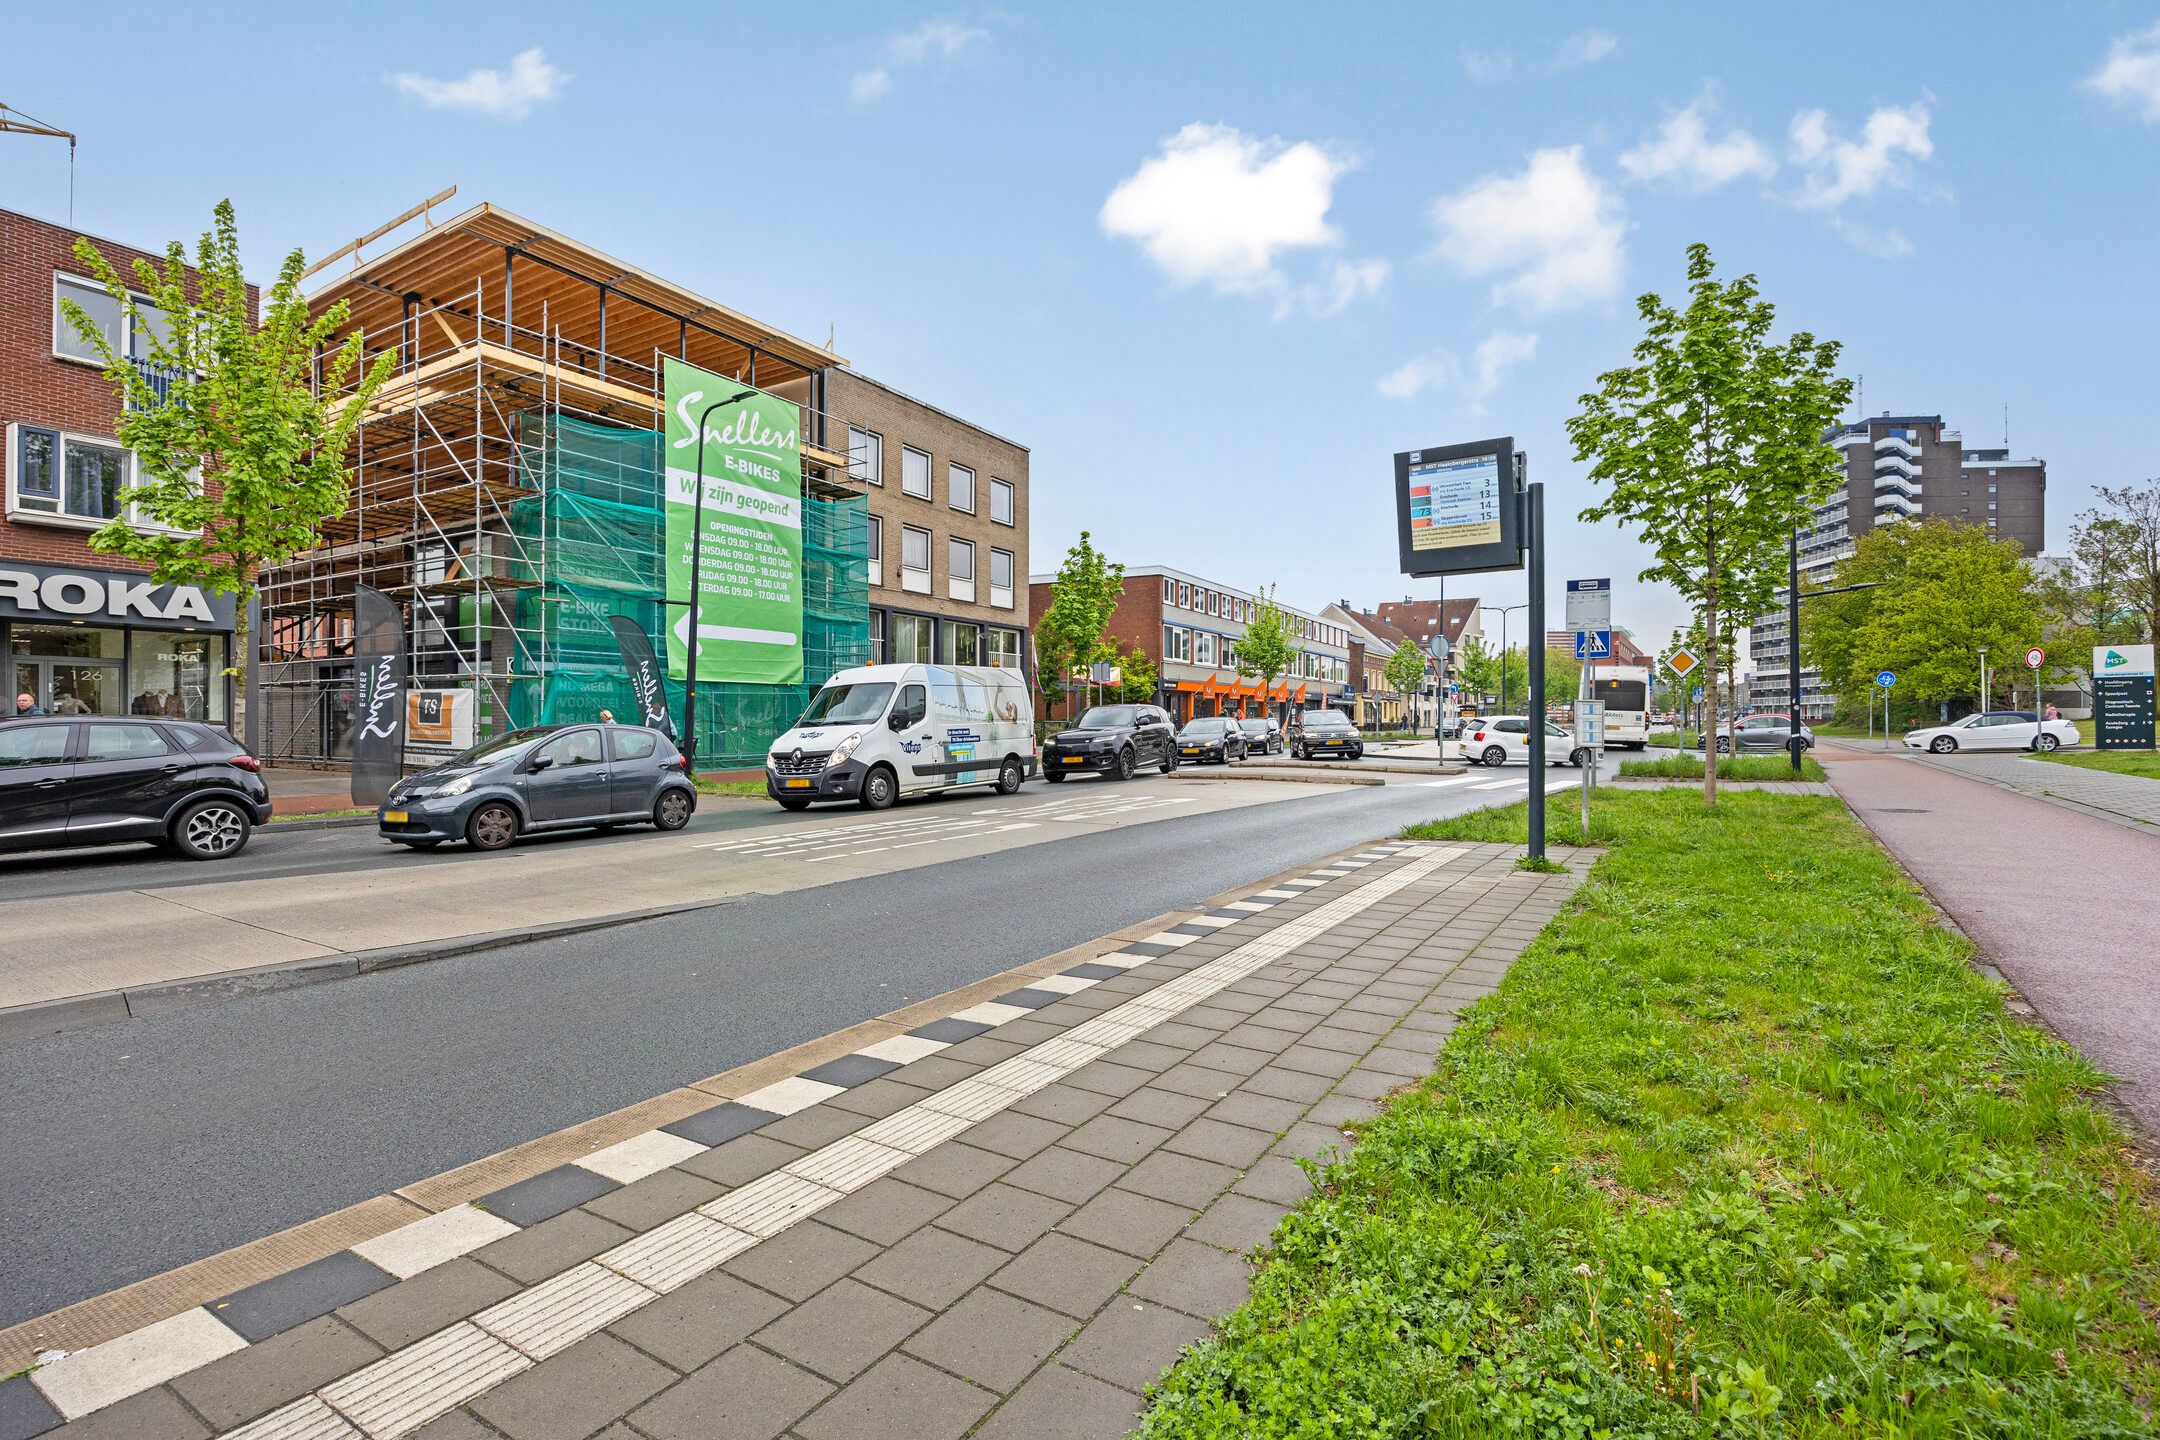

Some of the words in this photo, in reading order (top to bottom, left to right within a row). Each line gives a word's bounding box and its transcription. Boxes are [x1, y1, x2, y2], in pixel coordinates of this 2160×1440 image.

[724, 454, 780, 482] E-BIKES
[1484, 478, 1490, 487] 3
[680, 477, 705, 501] Wj
[708, 487, 733, 507] zijn
[736, 491, 789, 518] geopend
[1479, 489, 1491, 499] 13
[1419, 507, 1432, 516] 73
[1480, 500, 1492, 510] 14
[1480, 511, 1492, 521] 15
[691, 531, 726, 544] DNSDAG
[727, 537, 749, 549] 09.00
[755, 542, 773, 553] 18.00
[774, 546, 788, 556] UUR
[685, 542, 731, 558] WENSDAG
[733, 550, 754, 562] 09.00
[760, 555, 777, 566] 18.00
[778, 559, 792, 569] UUR
[683, 555, 733, 571] DODERDAG
[735, 562, 756, 574] 09.00
[761, 567, 778, 578] 18.00
[779, 571, 794, 581] UUR
[727, 573, 749, 585] 09.00
[754, 578, 772, 588] 18.00
[773, 581, 788, 591] UUR
[0, 569, 215, 622] ROKA
[688, 581, 730, 594] ZTERDAG
[731, 586, 753, 597] 09.00
[758, 590, 776, 601] 17.00
[776, 593, 791, 602] UUR
[157, 653, 199, 662] ROKA
[70, 670, 103, 681] 126
[580, 681, 614, 692] MEGA
[424, 699, 438, 715] TS
[900, 742, 922, 754] Vitens
